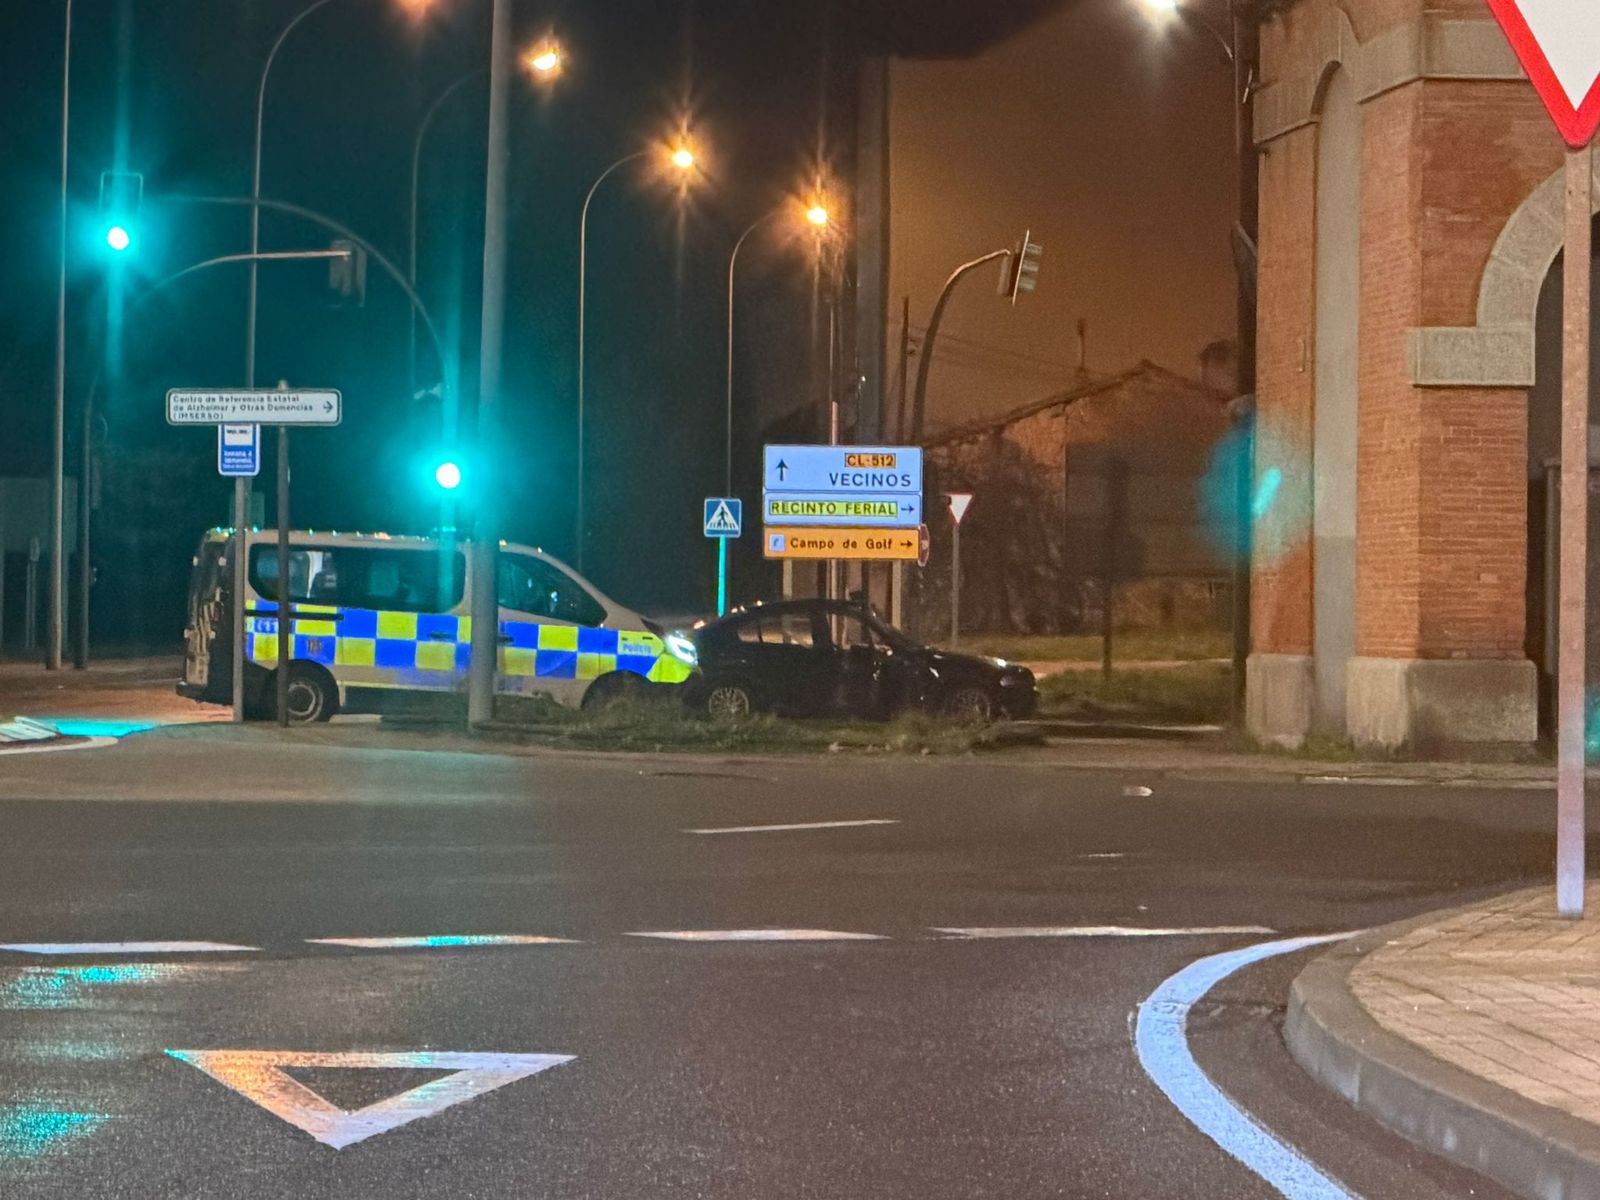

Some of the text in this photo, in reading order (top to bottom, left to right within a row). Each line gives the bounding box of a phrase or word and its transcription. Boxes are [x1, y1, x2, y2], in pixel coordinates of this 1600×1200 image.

[173, 395, 300, 403] Centro de Referencia Estatal
[173, 403, 185, 411] de
[187, 403, 229, 411] Alzheimer
[240, 403, 265, 411] Otras
[267, 403, 313, 411] Demencias
[846, 454, 895, 467] CL-512
[828, 472, 911, 487] VECINOS
[771, 502, 896, 515] RECINTO FERIAL
[790, 537, 893, 551] Campo de Golf
